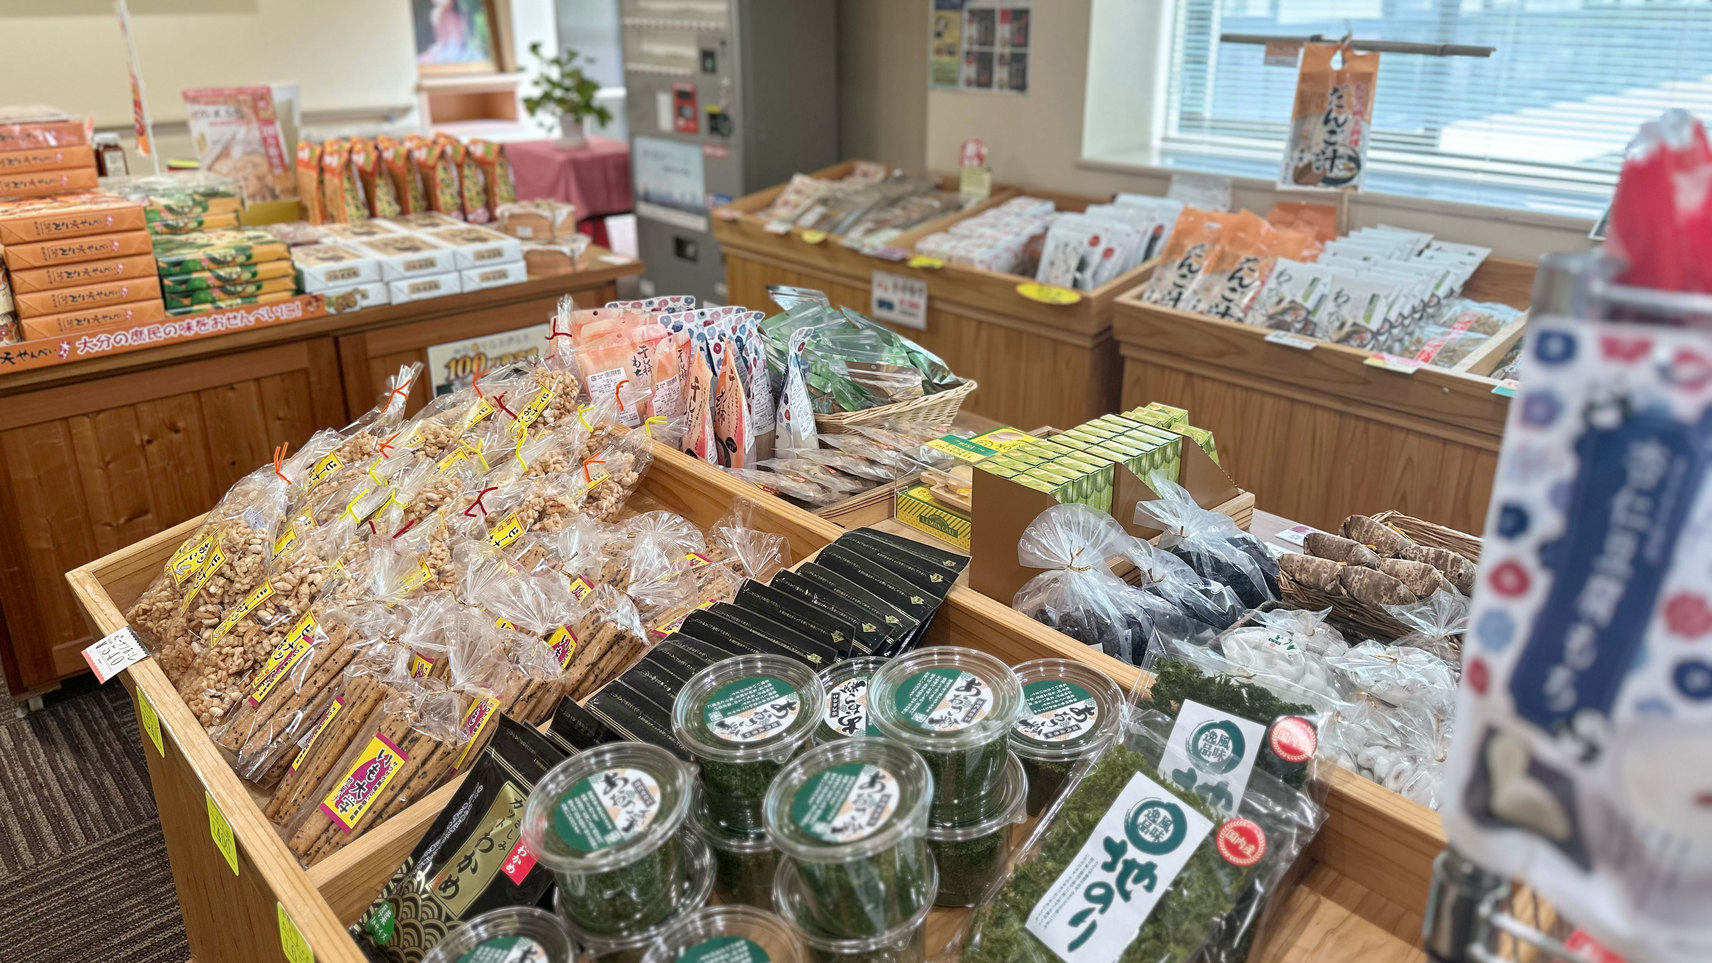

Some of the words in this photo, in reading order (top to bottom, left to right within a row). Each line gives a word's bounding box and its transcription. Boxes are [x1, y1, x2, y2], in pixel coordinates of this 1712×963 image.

[1314, 84, 1349, 173] だんご汁
[921, 517, 942, 529] LEMON
[941, 524, 956, 537] CAKE
[272, 620, 313, 664] ピーナツ
[1201, 730, 1218, 756] 逸品
[1213, 730, 1231, 762] 風味
[334, 747, 394, 818] いも大学
[1137, 807, 1161, 836] 逸品
[1150, 813, 1175, 844] 風味
[1225, 828, 1257, 858] 国内産
[506, 844, 530, 874] わかめ
[1066, 835, 1160, 953] 地のり
